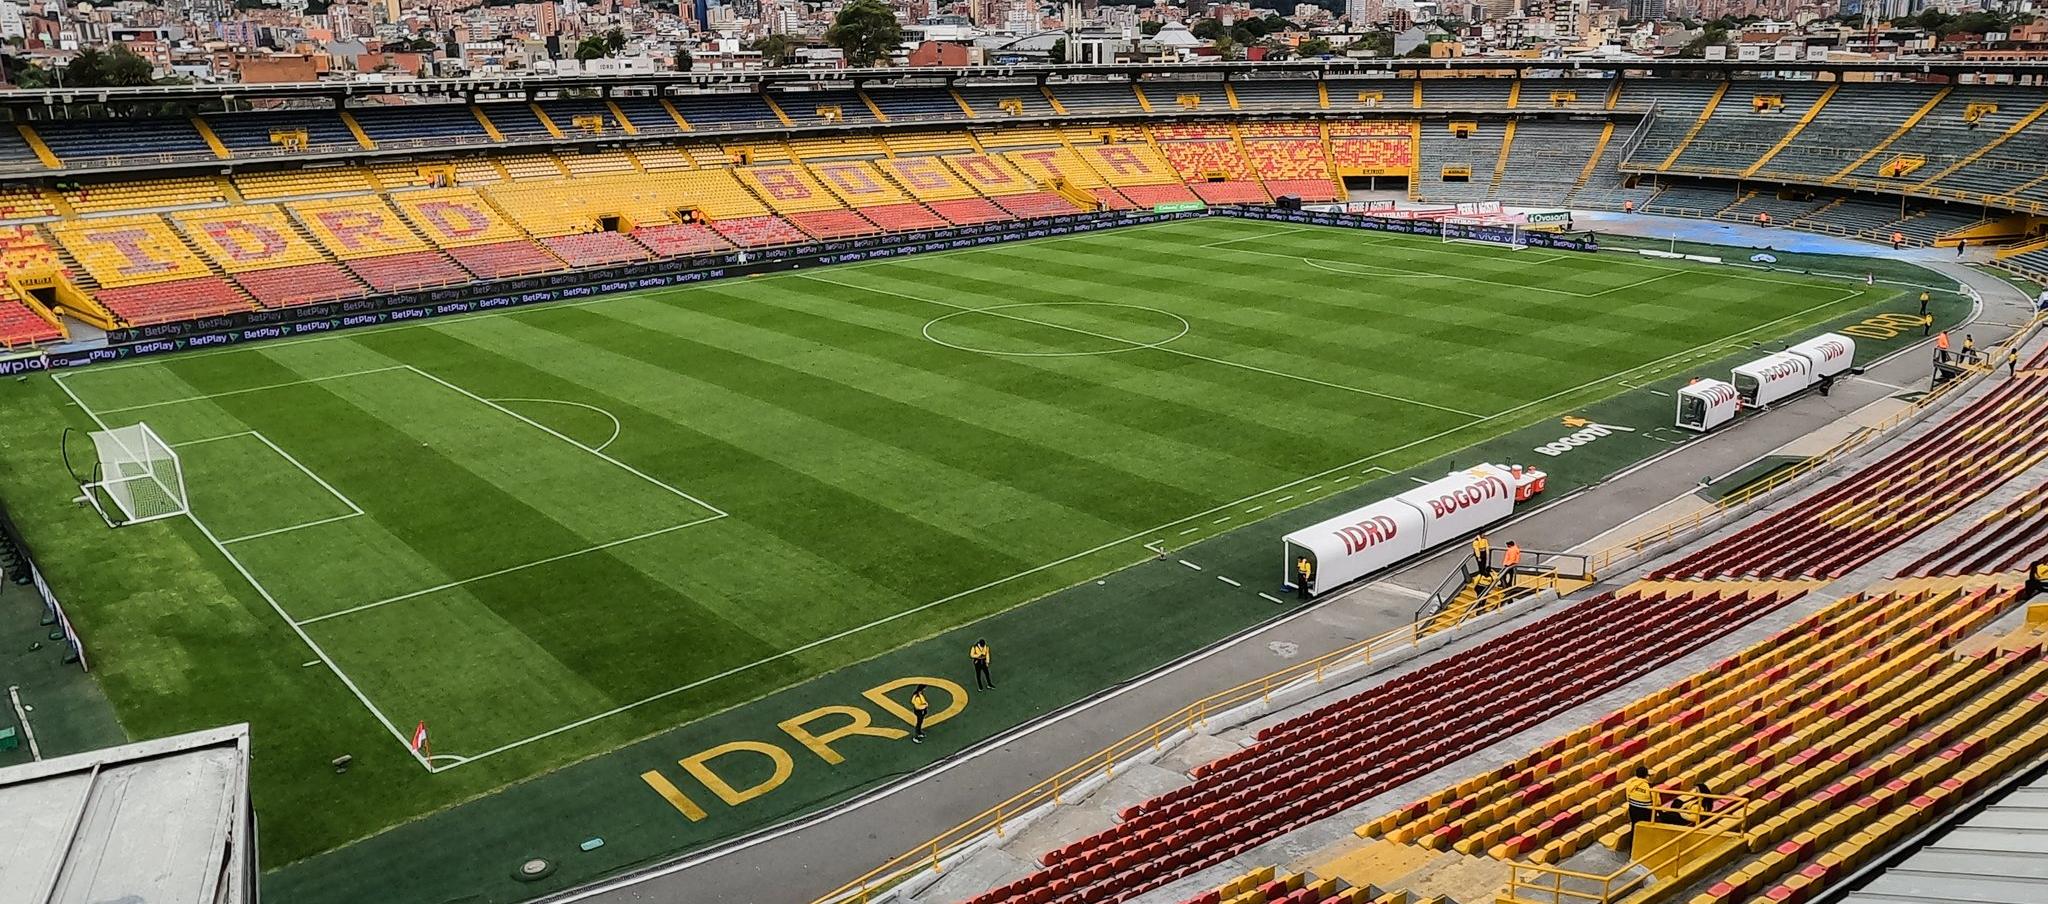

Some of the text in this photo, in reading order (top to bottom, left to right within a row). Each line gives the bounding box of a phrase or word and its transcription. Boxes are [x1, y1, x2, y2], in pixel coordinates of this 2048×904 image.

[135, 340, 174, 353] BetPlay
[190, 334, 227, 347] BetPlay
[244, 327, 280, 339] BetPlay
[296, 321, 330, 332] BetPlay
[343, 314, 376, 326] BetPlay
[391, 308, 424, 319] BetPlay
[438, 302, 468, 313] BetPlay
[480, 297, 510, 308] BetPlay
[522, 292, 551, 302] BetPlay
[564, 287, 591, 297] BetPlay
[601, 282, 628, 292] BetPlay
[640, 276, 665, 286] BetPlay
[676, 272, 701, 282] BetPlay
[145, 325, 181, 336] BetPlay
[296, 306, 329, 317] BetPlay
[343, 300, 375, 311] BetPlay
[1837, 313, 1926, 340] IDRD
[1523, 484, 1532, 498] G
[1332, 515, 1398, 556] IDRD
[640, 676, 969, 822] IDRD
